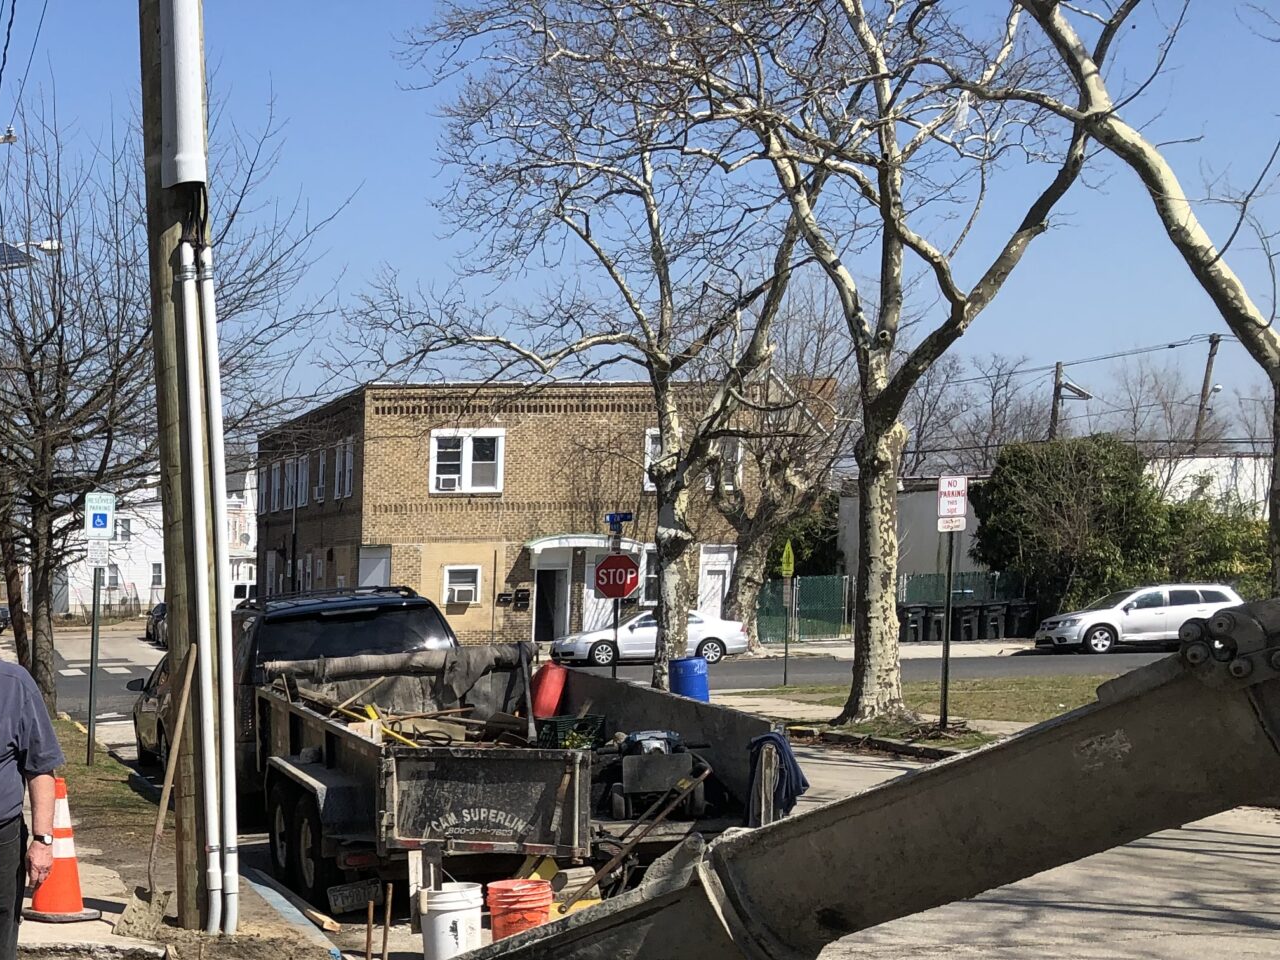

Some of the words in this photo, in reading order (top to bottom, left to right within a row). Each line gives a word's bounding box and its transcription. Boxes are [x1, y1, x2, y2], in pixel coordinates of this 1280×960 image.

[947, 480, 958, 488] NO
[940, 490, 965, 498] PARKING
[598, 568, 637, 585] STOP
